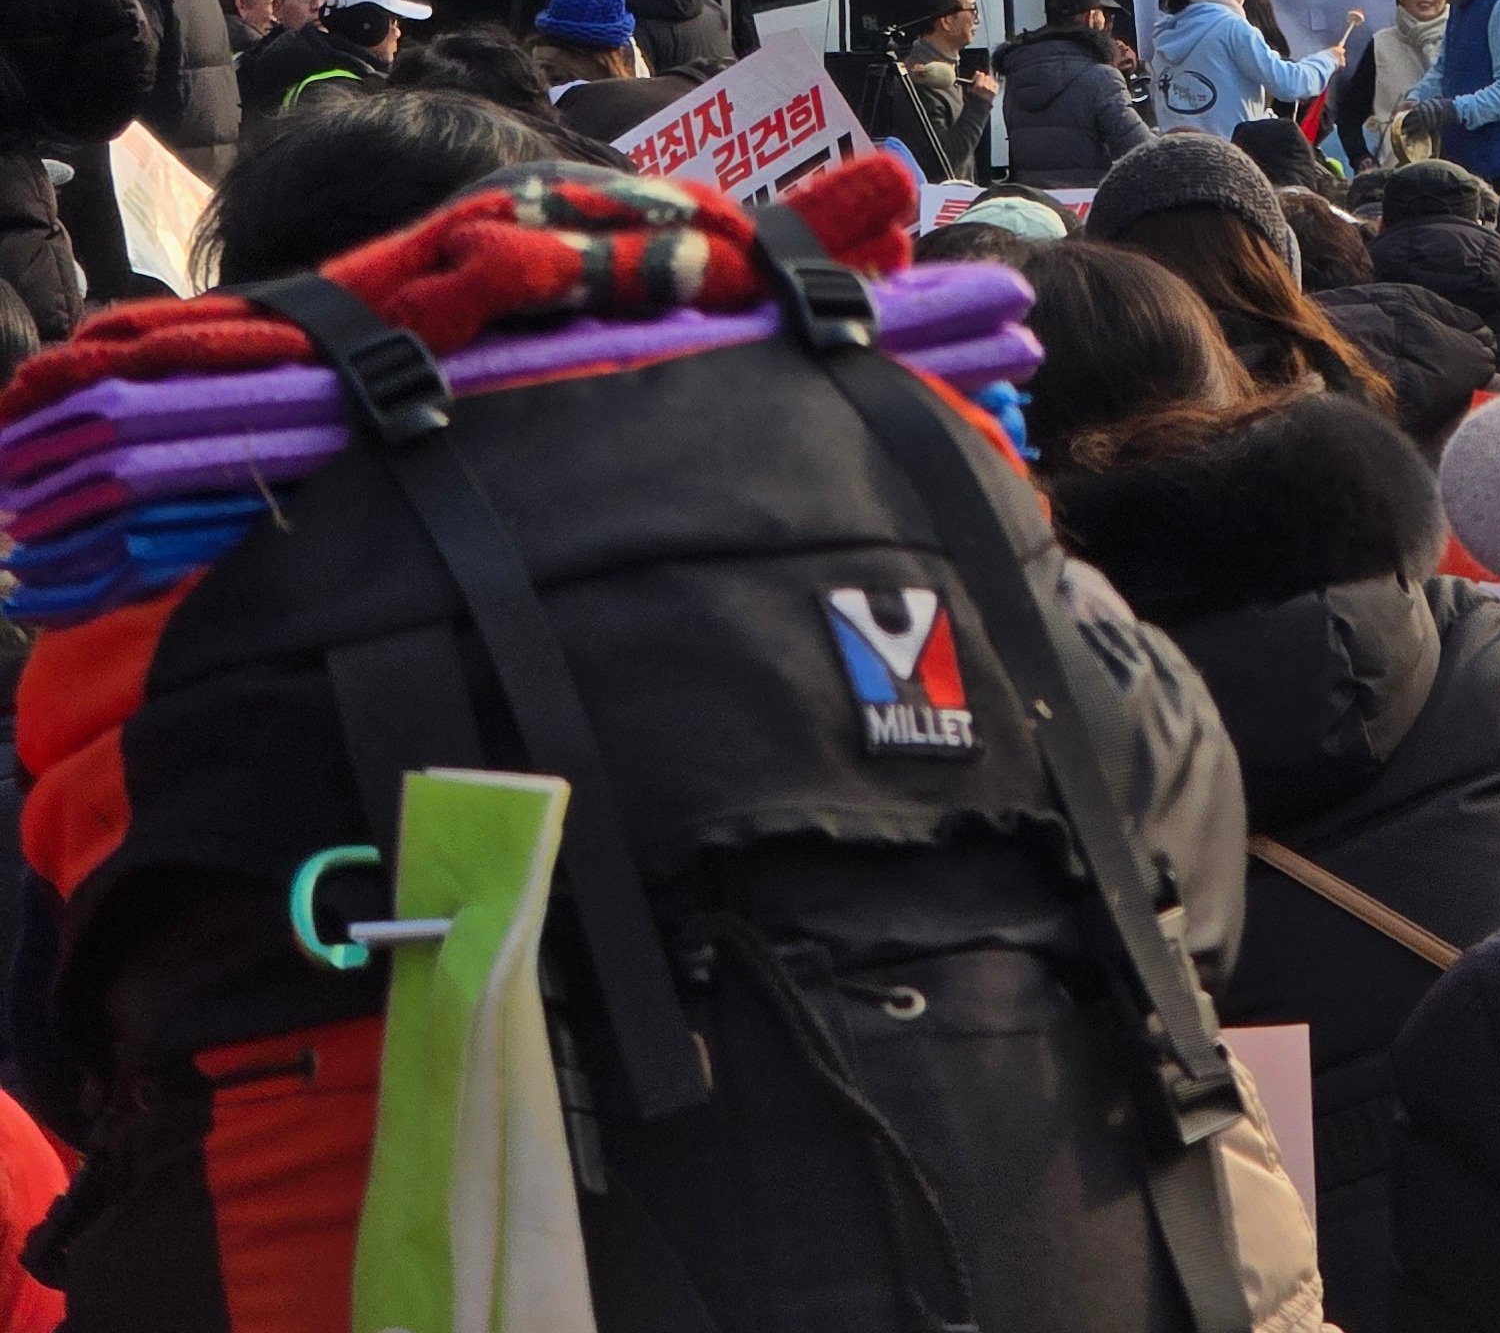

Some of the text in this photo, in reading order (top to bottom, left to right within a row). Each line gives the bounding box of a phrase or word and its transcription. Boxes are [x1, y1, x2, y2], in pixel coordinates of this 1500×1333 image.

[625, 88, 734, 181] 범죄자
[712, 85, 826, 194] 김건희
[862, 704, 973, 749] MILLET
